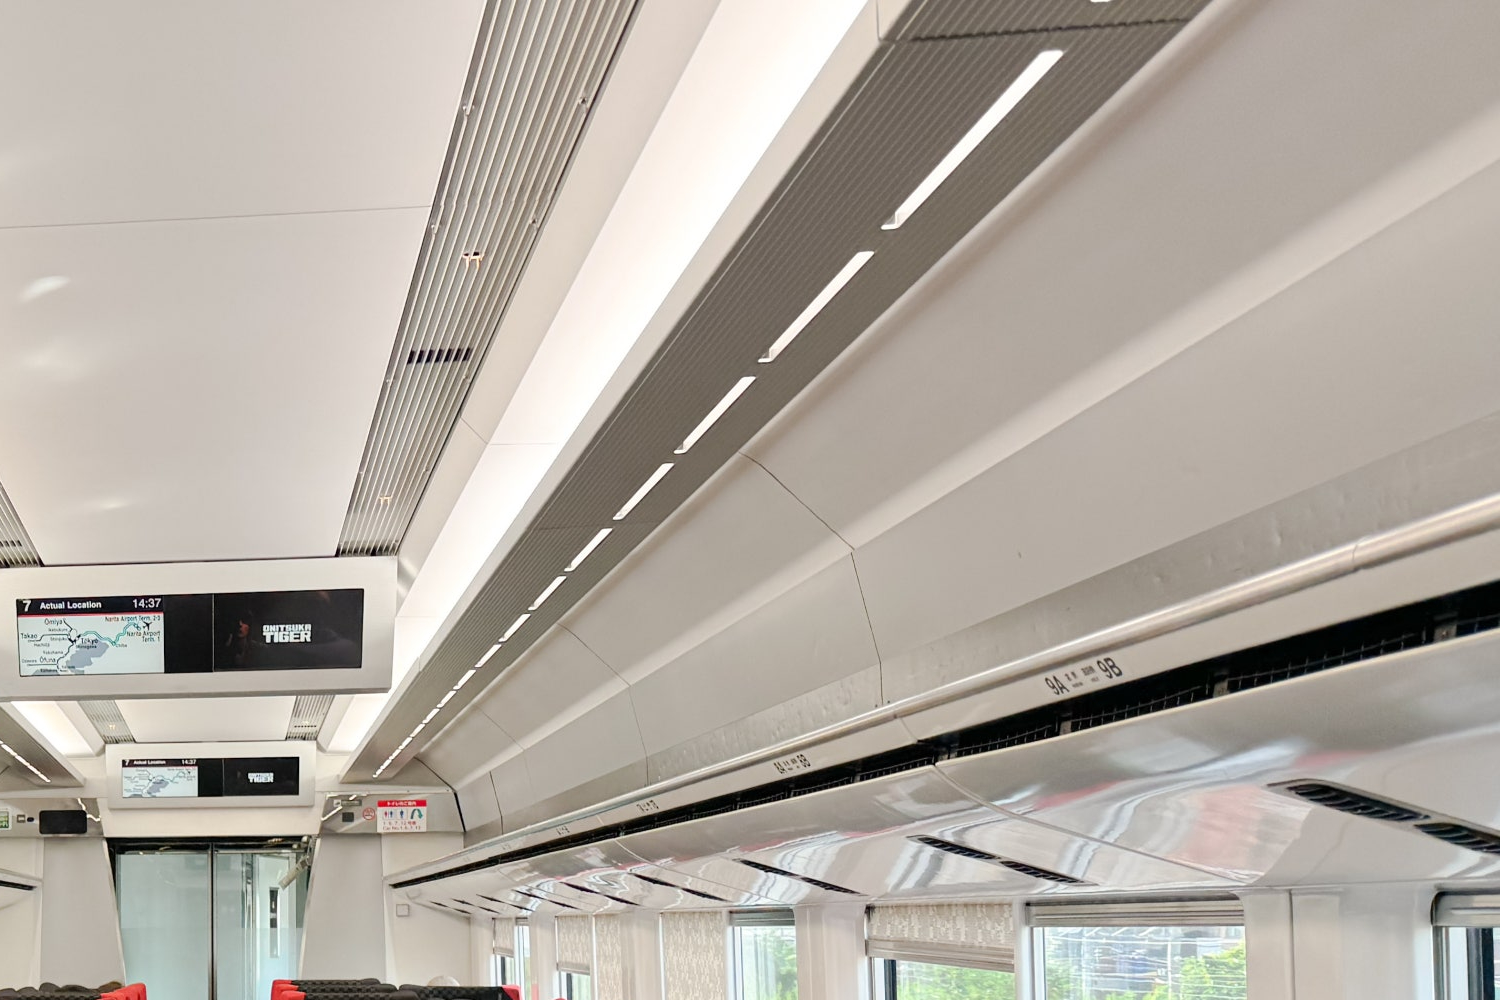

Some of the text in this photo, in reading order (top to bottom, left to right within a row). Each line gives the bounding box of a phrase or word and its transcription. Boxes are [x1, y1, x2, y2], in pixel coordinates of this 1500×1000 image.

[23, 598, 162, 612] 7 Actual Location 14:37
[142, 630, 160, 638] Airport
[263, 624, 312, 632] ONITSUKA
[263, 631, 311, 644] TIGER
[1045, 676, 1070, 695] 9A
[1097, 658, 1123, 679] 9B
